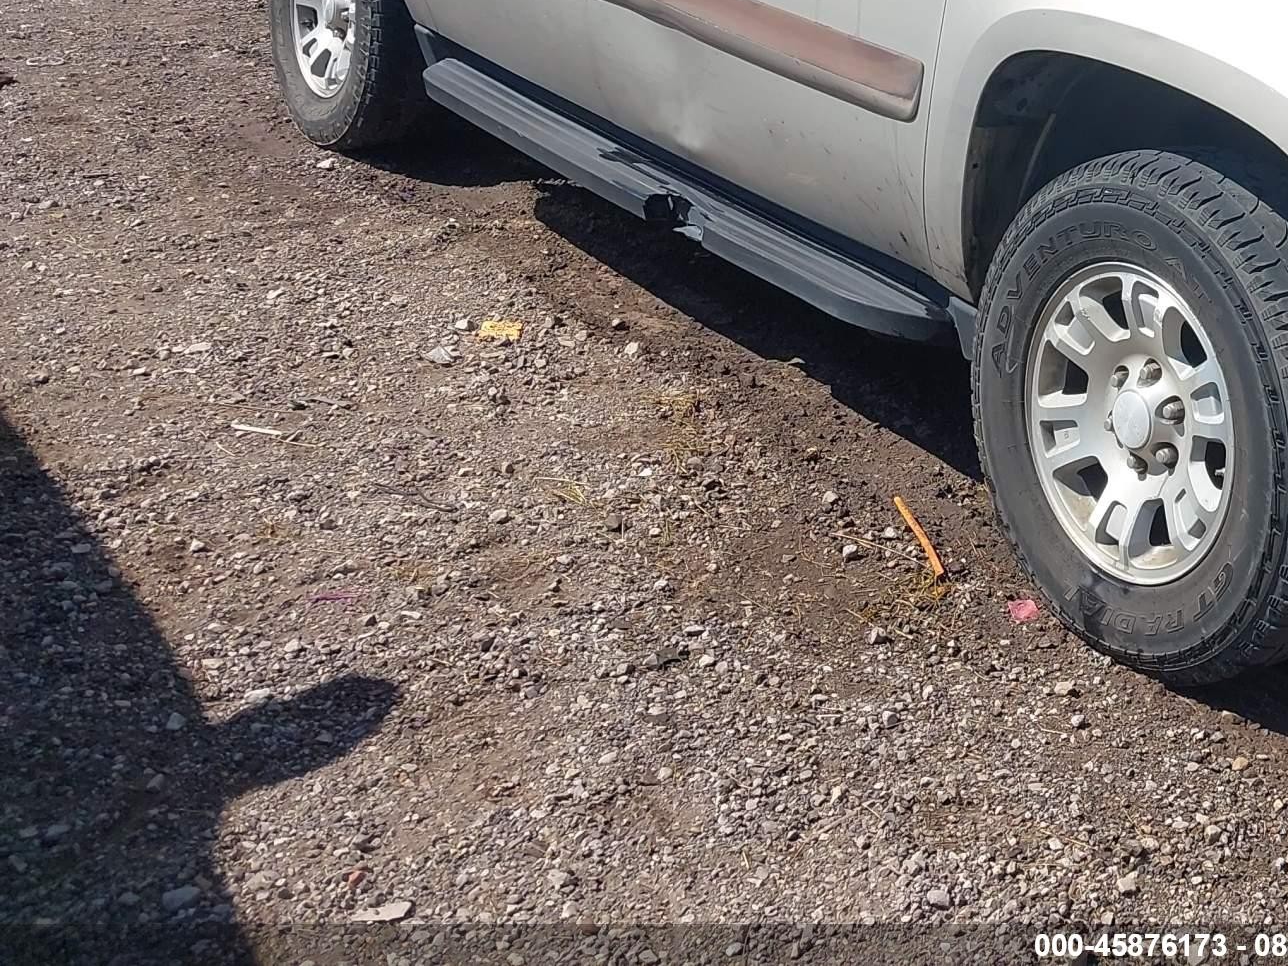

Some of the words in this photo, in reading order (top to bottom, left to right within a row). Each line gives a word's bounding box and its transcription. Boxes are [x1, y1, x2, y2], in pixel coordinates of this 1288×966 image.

[991, 221, 1158, 378] ADVENTURO
[1063, 586, 1185, 636] RADIAL
[1193, 561, 1234, 622] GT
